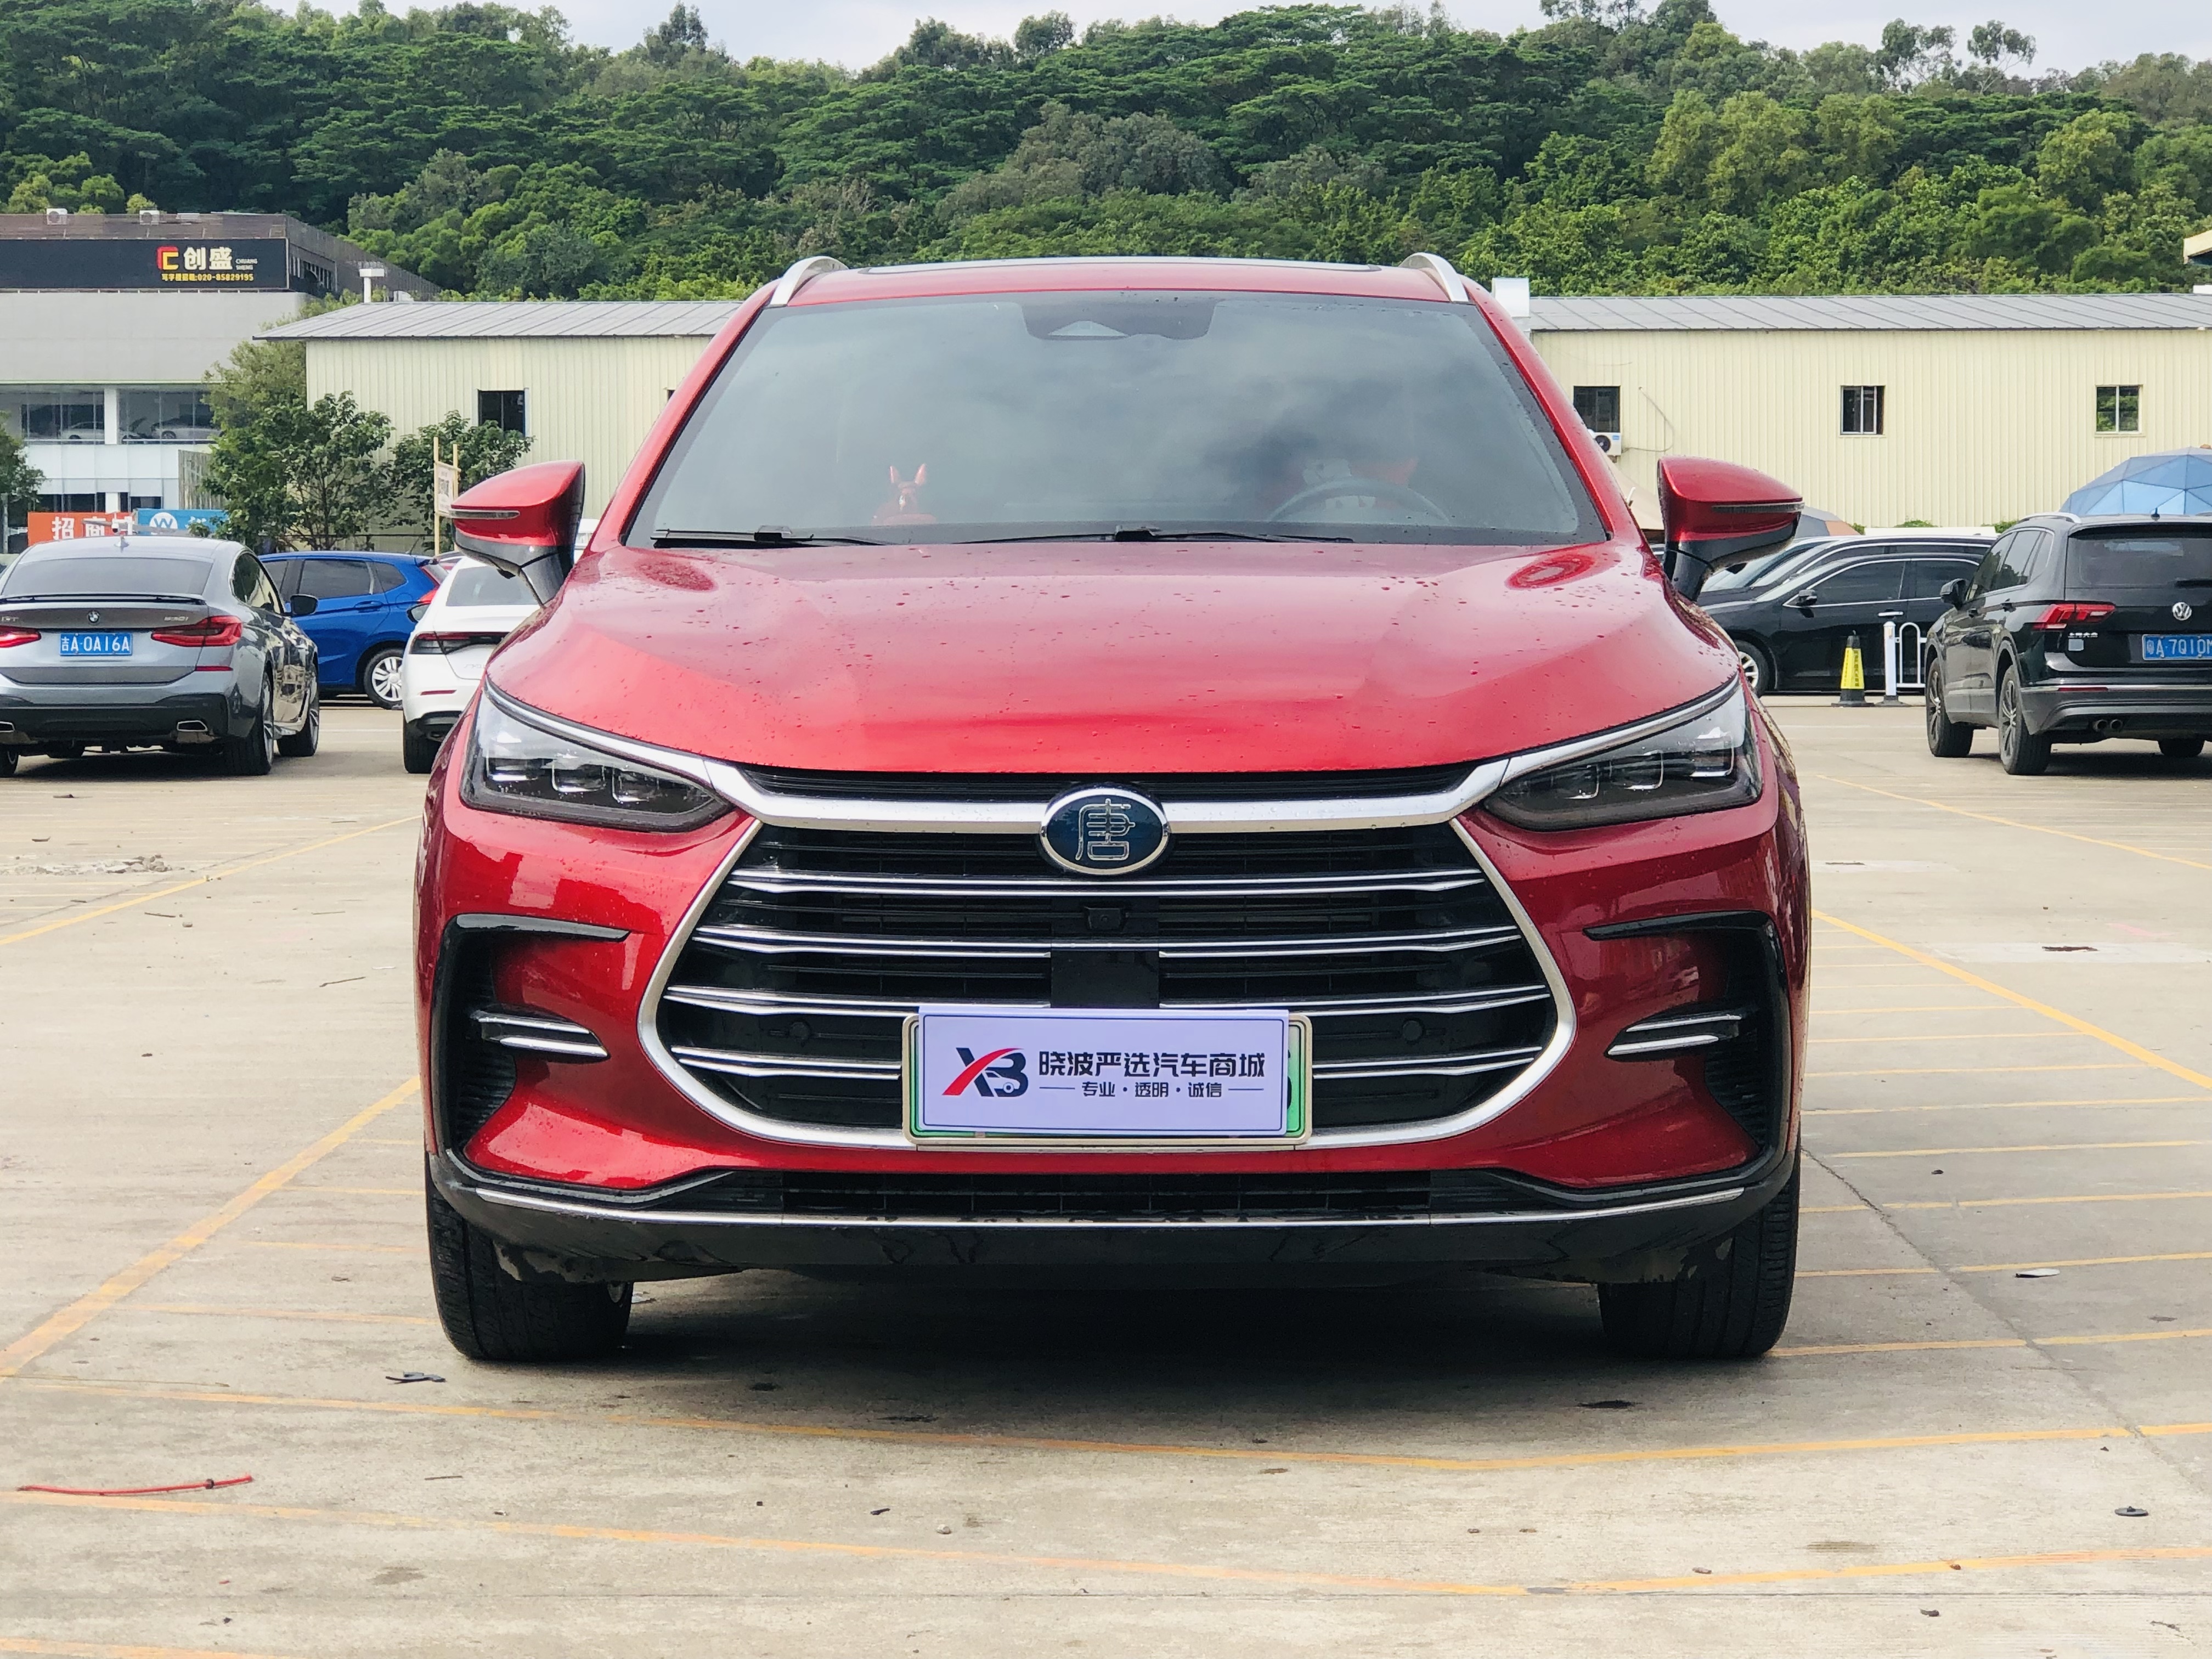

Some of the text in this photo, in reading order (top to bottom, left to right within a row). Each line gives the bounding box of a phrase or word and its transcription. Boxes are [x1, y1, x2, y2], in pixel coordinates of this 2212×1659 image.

[184, 246, 233, 270] 创盛
[1039, 1051, 1265, 1078] 晓波严选汽车商城
